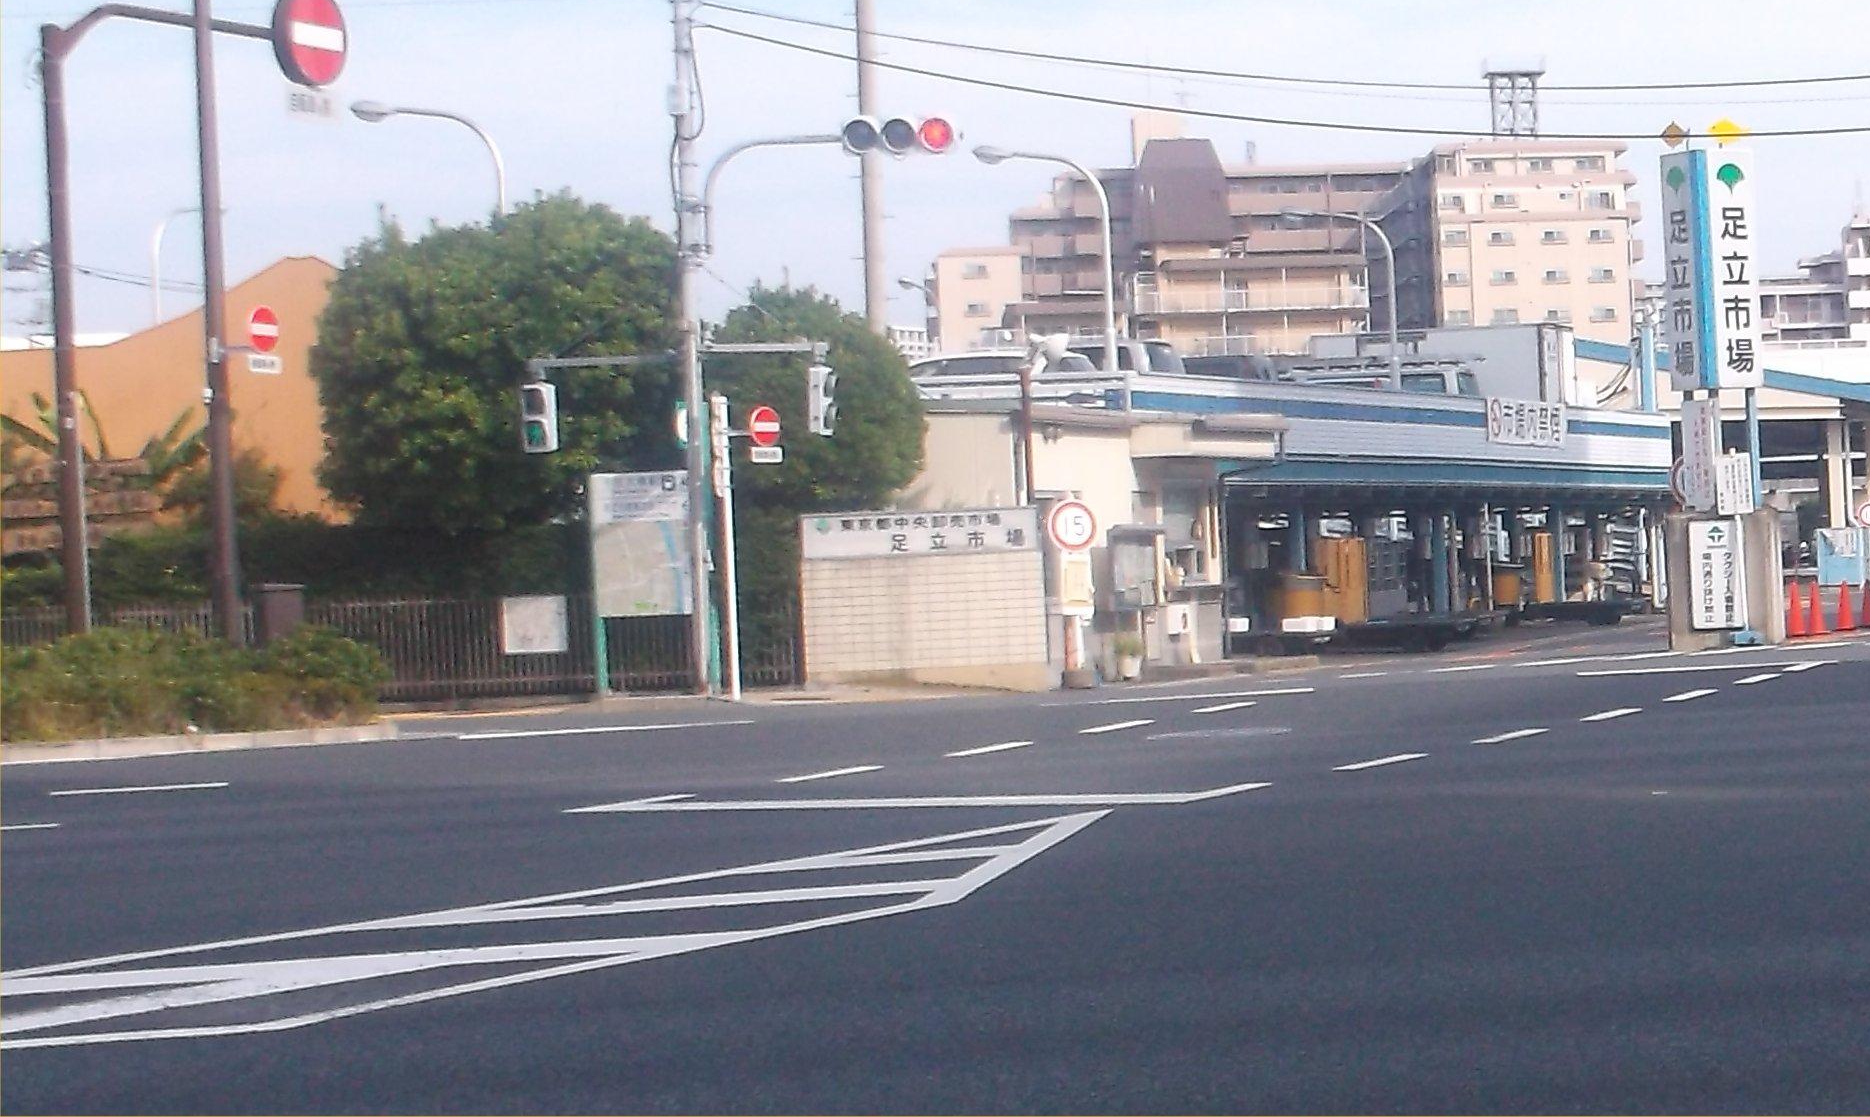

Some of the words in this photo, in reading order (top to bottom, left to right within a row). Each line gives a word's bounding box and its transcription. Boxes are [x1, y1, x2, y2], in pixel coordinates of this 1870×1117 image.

[1671, 209, 1695, 377] 足立市場
[1721, 206, 1755, 374] 足立市場
[840, 513, 1001, 532] 東京都中央卸売市場
[1063, 514, 1086, 537] 15
[890, 527, 1028, 552] 足立市場
